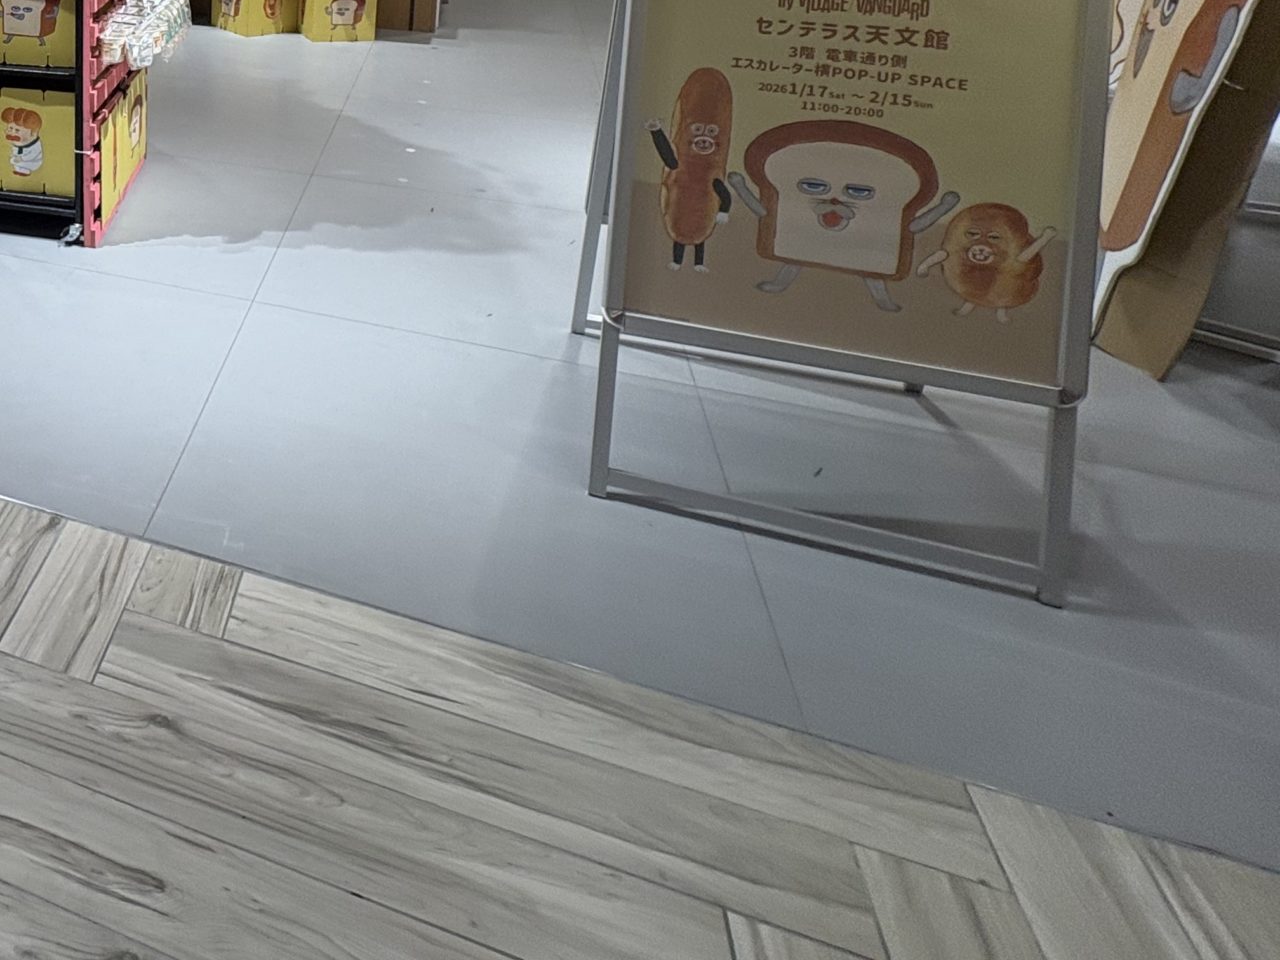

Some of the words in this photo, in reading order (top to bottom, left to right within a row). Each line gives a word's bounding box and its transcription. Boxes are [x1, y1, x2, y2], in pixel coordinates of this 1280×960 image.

[756, 16, 950, 50] センテラス天文館
[788, 46, 816, 60] 3階
[826, 48, 908, 69] 電車通り側
[908, 74, 969, 91] SPACE
[800, 101, 884, 118] 11:00-20:00
